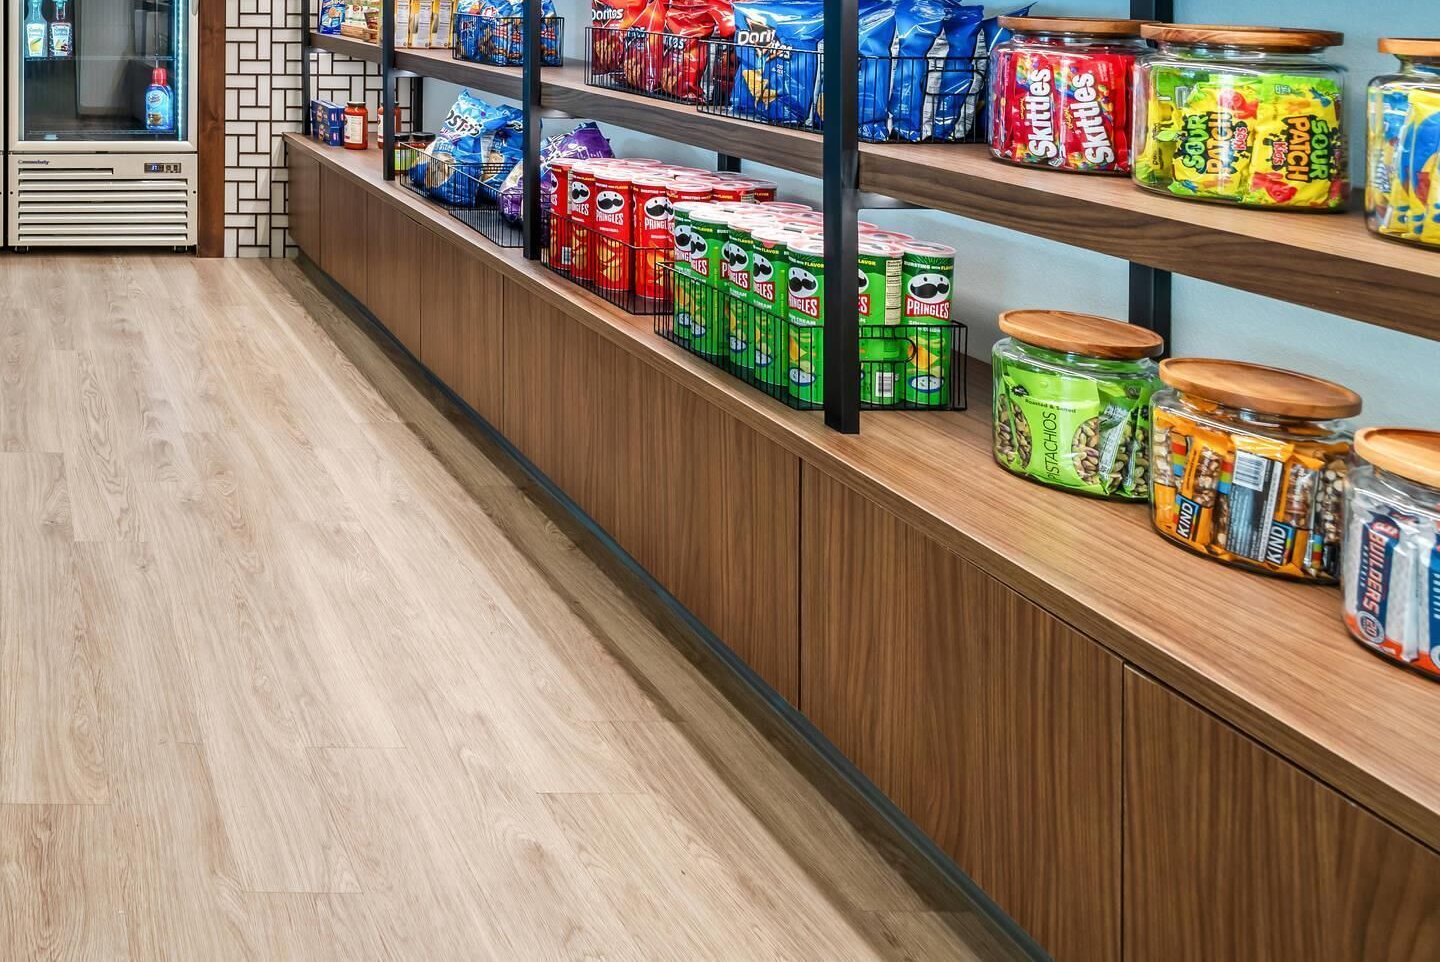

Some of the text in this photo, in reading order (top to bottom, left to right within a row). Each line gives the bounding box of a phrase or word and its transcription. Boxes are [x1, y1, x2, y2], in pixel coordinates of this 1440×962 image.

[592, 7, 624, 21] Doritos
[1024, 68, 1058, 159] Skittles
[1070, 71, 1115, 165] Skittles
[1183, 114, 1210, 169] SOUR
[1206, 111, 1233, 175] PATCH
[1272, 141, 1289, 166] Kids
[1285, 115, 1311, 182] PATCH
[1309, 118, 1330, 180] SOUR
[596, 209, 624, 226] PRINGLES
[644, 216, 667, 231] PRINGL
[858, 259, 876, 267] LAVOR
[906, 298, 949, 319] PRINGLES
[1025, 398, 1049, 409] Roasted
[1177, 501, 1194, 539] KIND
[1265, 525, 1287, 565] KIND
[1363, 530, 1387, 617] BUILDERS
